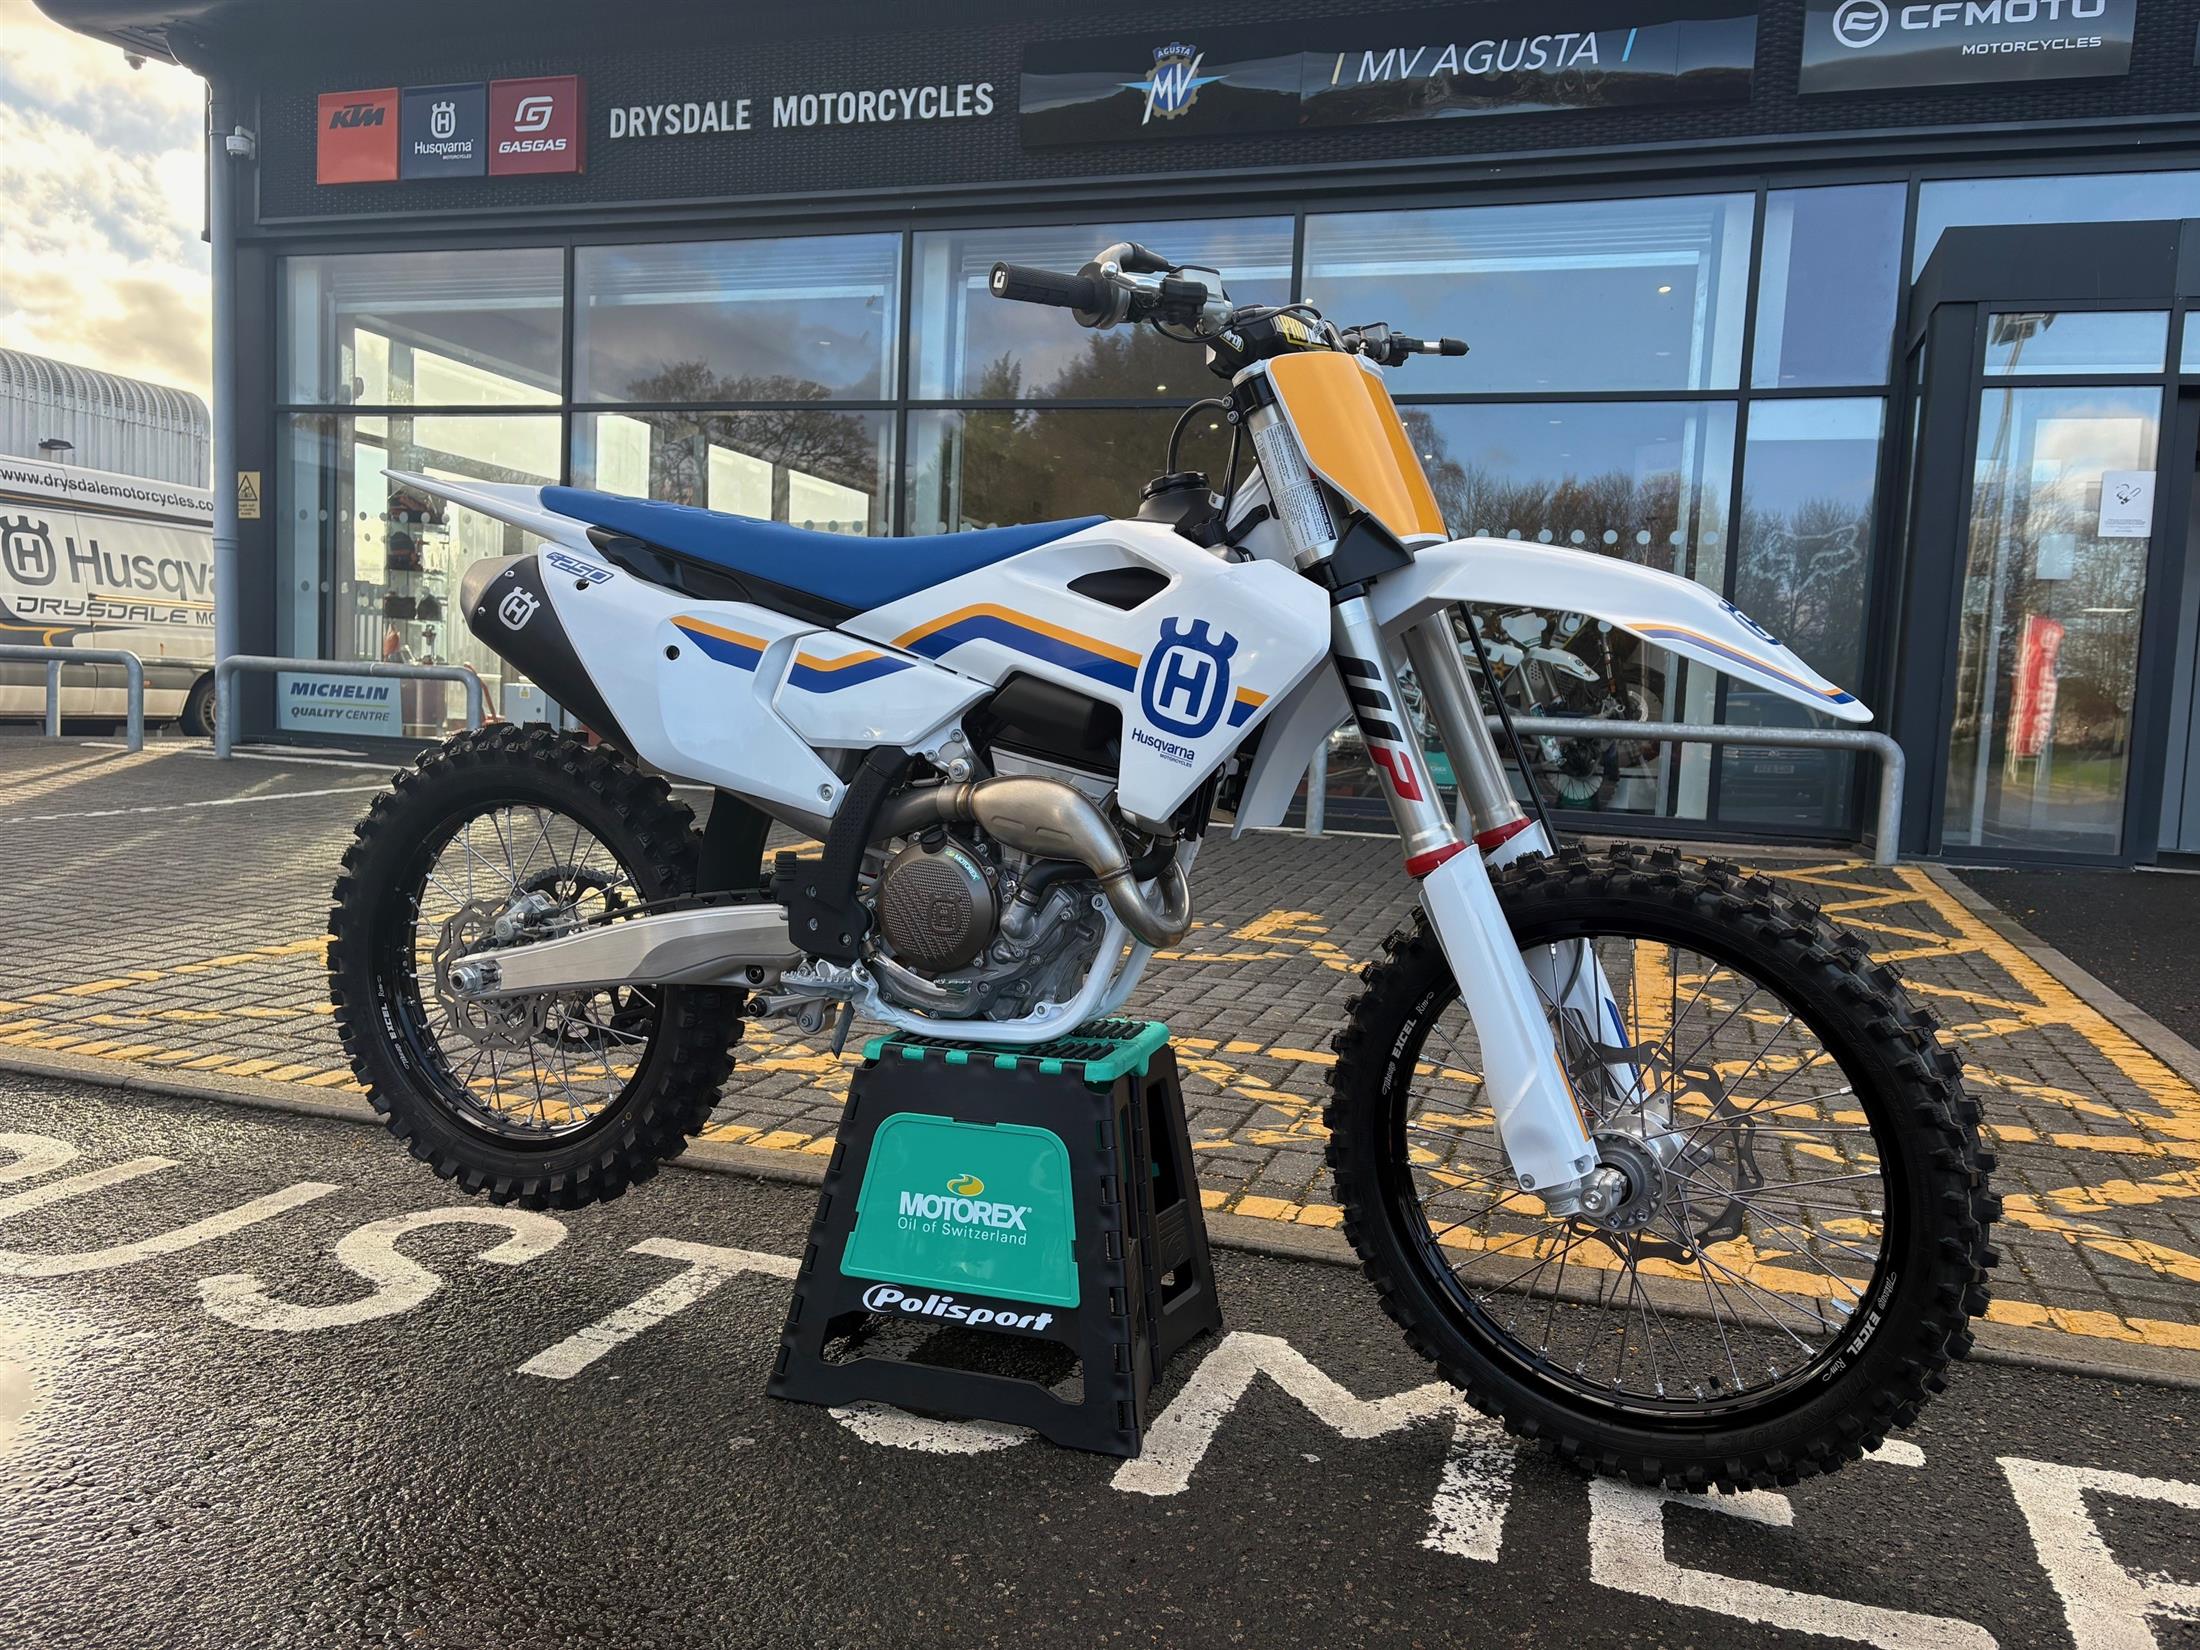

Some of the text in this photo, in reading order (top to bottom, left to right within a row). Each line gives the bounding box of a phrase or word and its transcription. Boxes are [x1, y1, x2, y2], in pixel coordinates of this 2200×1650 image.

[1901, 0, 2106, 30] CFMOTO
[1158, 46, 1191, 57] AGUSTA
[1358, 31, 1600, 83] MV AGUSTA
[1961, 37, 2102, 55] MOTORCYCLES
[1142, 51, 1205, 126] MV
[329, 103, 385, 129] KTM
[609, 82, 995, 139] DRYSDALE MOTORCYCLES
[414, 140, 474, 156] Husqvarna
[498, 138, 567, 154] GASGAS
[0, 468, 214, 512] www.drysdalemotorcycles.co
[552, 556, 614, 584] 250
[16, 596, 188, 624] DRYSDALE
[290, 682, 389, 701] MICHELIN
[291, 706, 390, 722] QUALITY CENTRE
[1131, 727, 1195, 760] Husqvarna
[1160, 753, 1193, 768] MOTORCYCLES
[954, 853, 980, 880] MOTOREX
[381, 1002, 397, 1040] EXCEL
[1391, 1019, 1417, 1059] EXCEL
[899, 1191, 1029, 1231] MOTOREX
[897, 1217, 1027, 1246] Oil of Switzerland
[863, 1284, 1054, 1331] Polisport
[1846, 1311, 1881, 1356] EXCEL
[1822, 1357, 1847, 1382] Rim
